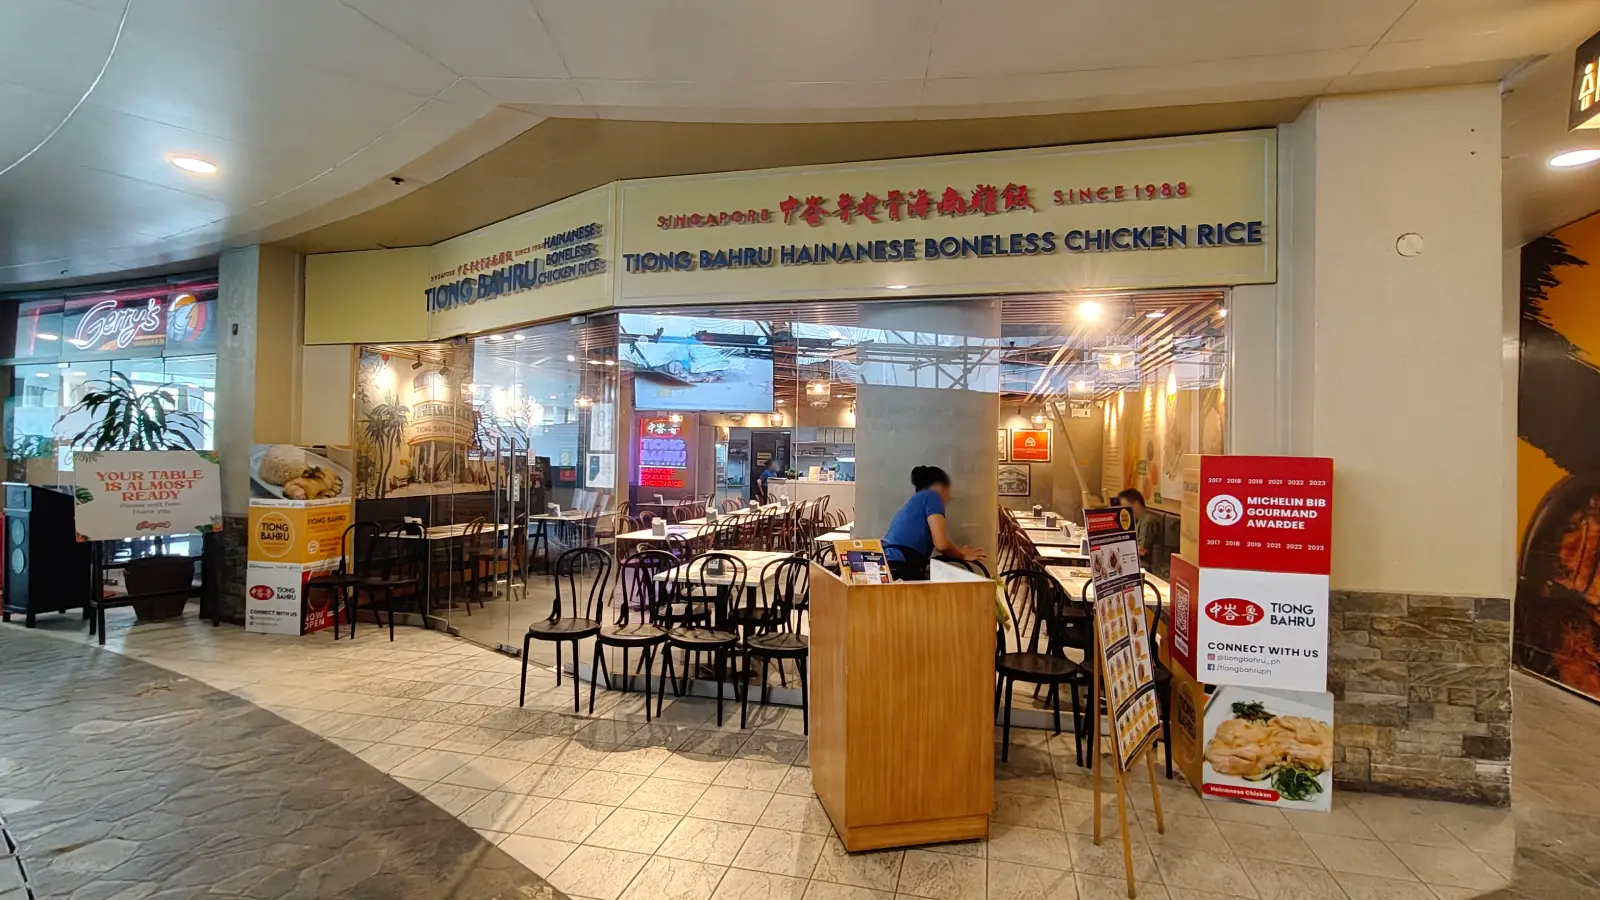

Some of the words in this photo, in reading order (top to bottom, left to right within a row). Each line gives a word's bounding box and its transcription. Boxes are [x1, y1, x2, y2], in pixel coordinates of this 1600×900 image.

[1053, 185, 1125, 205] SINCE
[1134, 182, 1188, 200] 1988
[657, 209, 770, 230] SINGAPORE
[544, 222, 601, 250] HAINANESE
[622, 250, 694, 273] TIONG
[699, 246, 773, 270] BAHRU
[780, 239, 915, 266] HAINANESE
[924, 231, 1056, 260] BONELESS
[1064, 223, 1187, 254] CHICKEN
[1197, 220, 1263, 246] RICE
[546, 243, 597, 266] BONELESS
[538, 263, 578, 284] CHICKEN
[579, 258, 604, 276] RICE
[425, 278, 476, 312] TIONG
[477, 258, 542, 300] BAHRU
[75, 298, 161, 349] Gerry's
[95, 470, 144, 482] YOUR
[148, 469, 204, 480] TABLE
[105, 481, 122, 491] IS
[125, 480, 196, 491] ALMOST
[122, 490, 180, 501] READY
[1247, 496, 1303, 506] MICHELIN
[1306, 498, 1326, 507] BIB
[1247, 508, 1318, 519] GOURMAND
[261, 522, 289, 532] TIONG
[1246, 519, 1305, 529] AWARDEE
[261, 531, 290, 541] BAHRU
[1270, 602, 1314, 615] TIONG
[1270, 615, 1316, 627] BAHRU
[1207, 641, 1265, 653] CONNECT
[1268, 646, 1300, 656] WITH
[1303, 649, 1319, 658] US
[1210, 786, 1244, 795] Hainanese
[1245, 790, 1272, 798] Chicken
